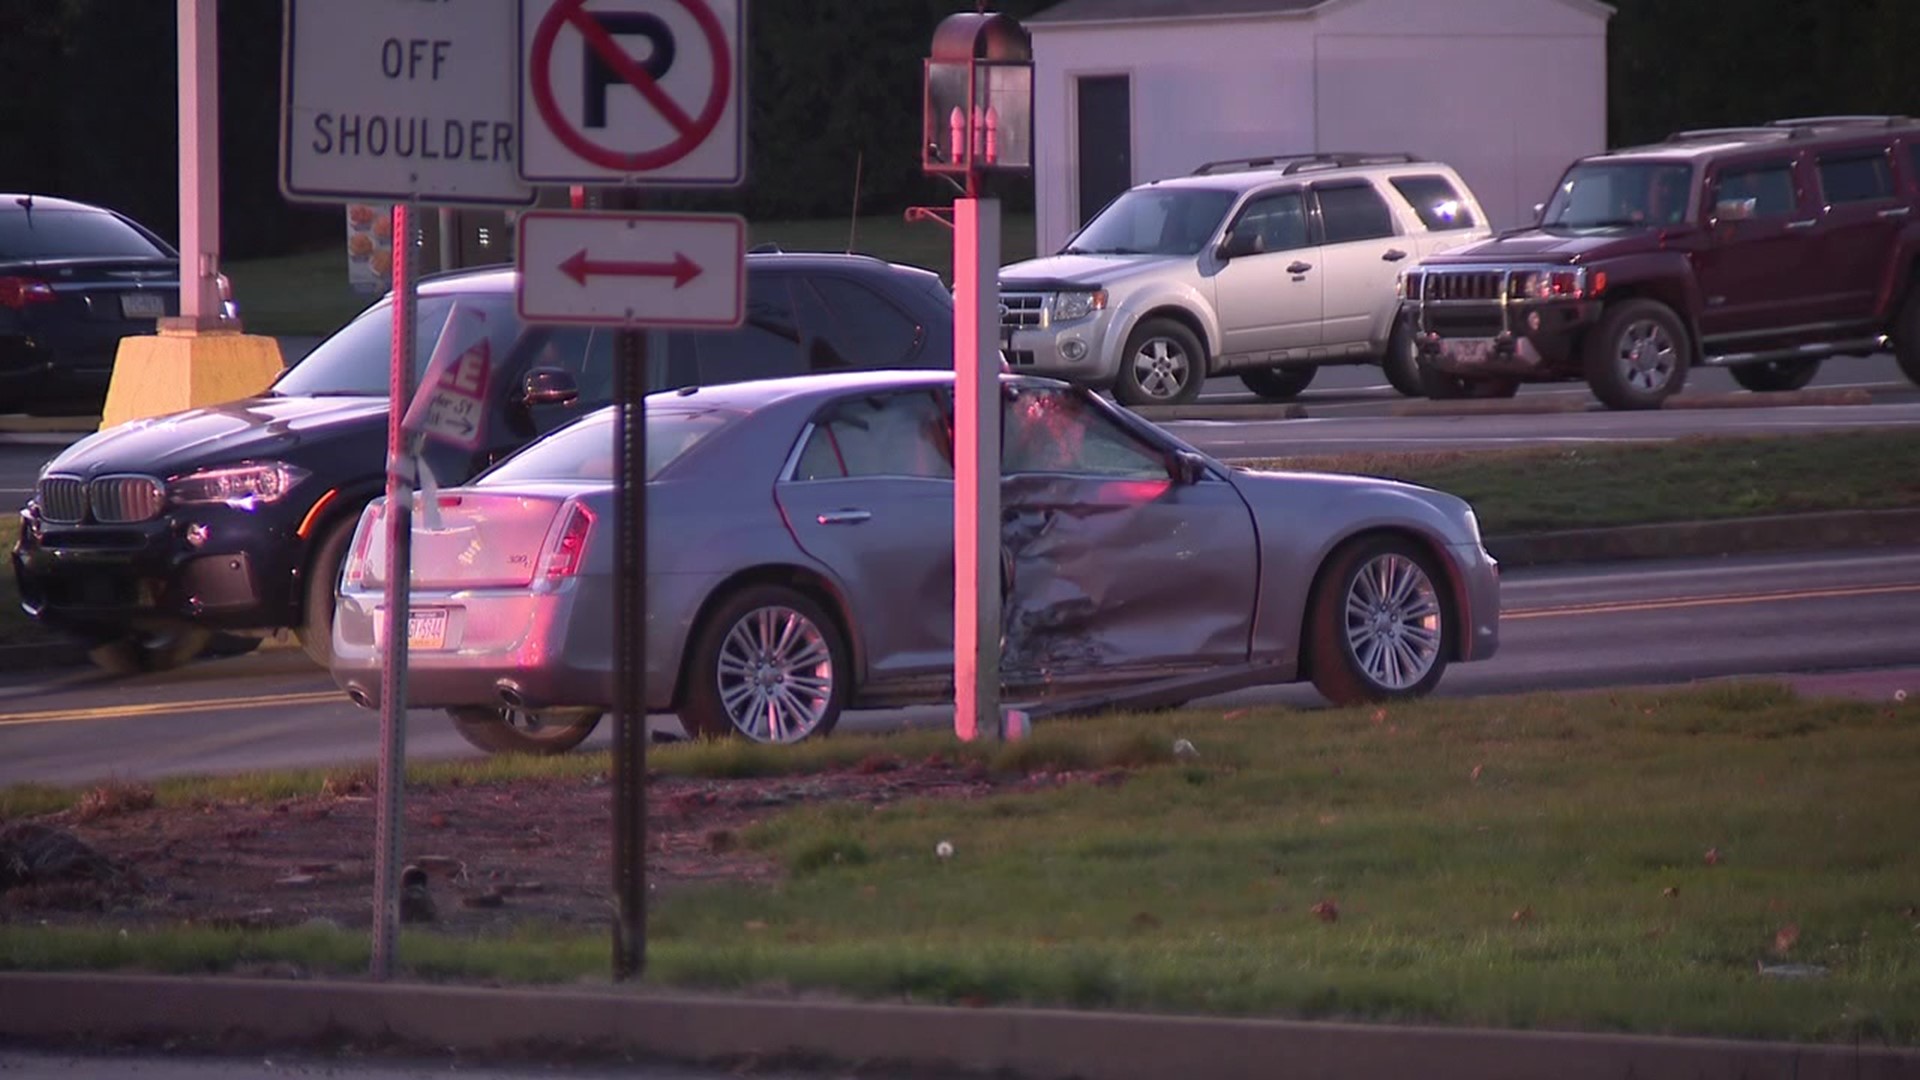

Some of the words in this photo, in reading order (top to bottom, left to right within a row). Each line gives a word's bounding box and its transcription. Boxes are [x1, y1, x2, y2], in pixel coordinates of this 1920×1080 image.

[381, 37, 452, 80] OFF
[583, 11, 676, 128] P
[312, 112, 514, 162] SHOULDER
